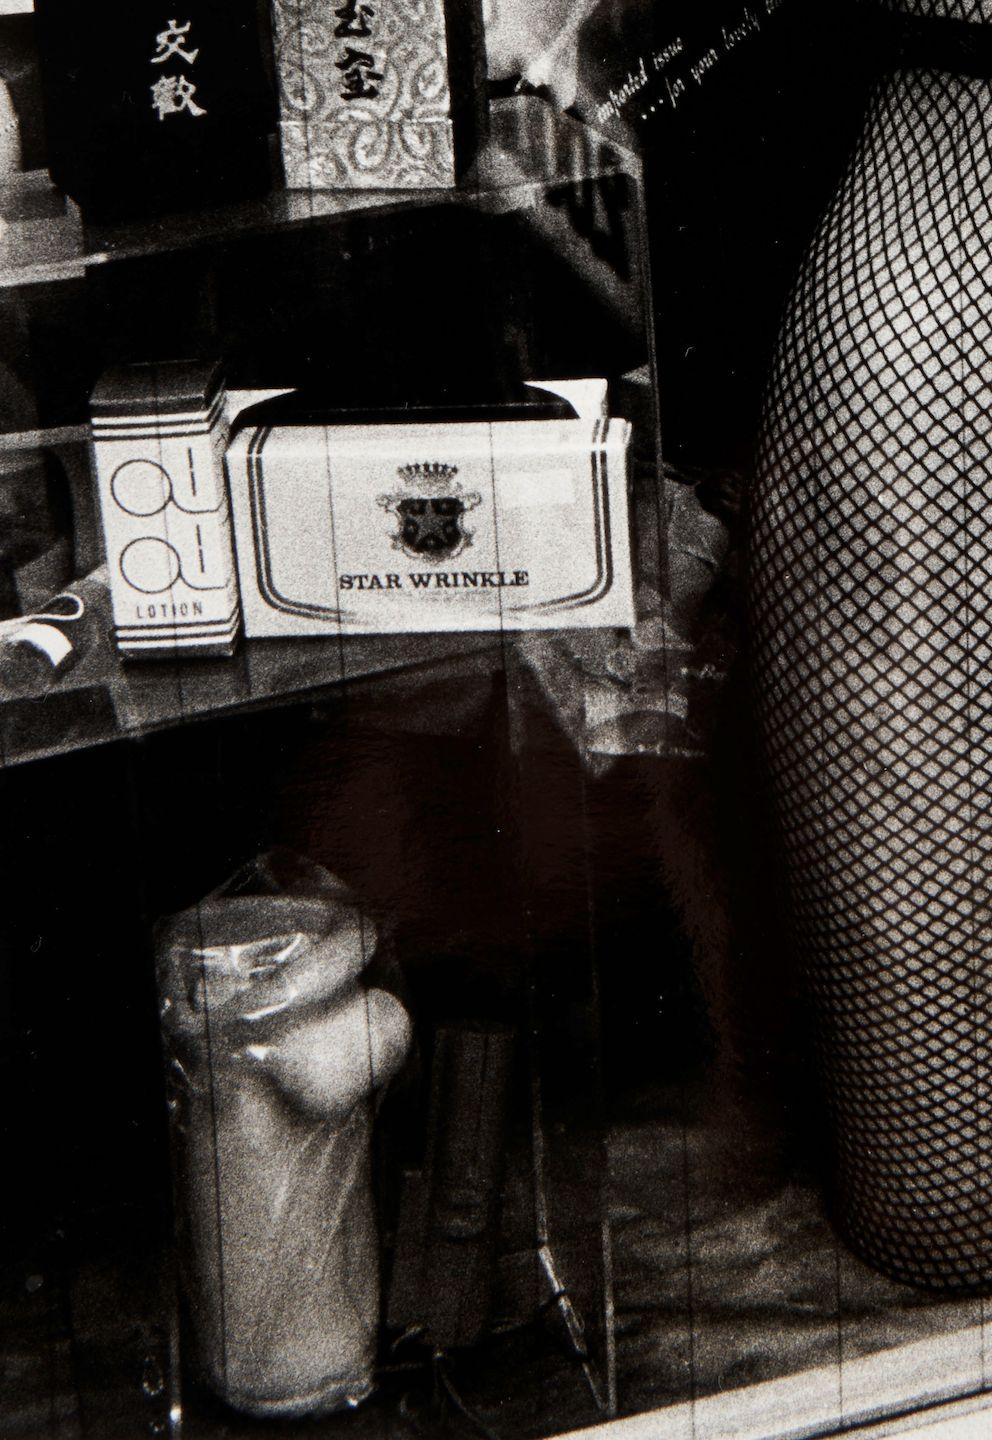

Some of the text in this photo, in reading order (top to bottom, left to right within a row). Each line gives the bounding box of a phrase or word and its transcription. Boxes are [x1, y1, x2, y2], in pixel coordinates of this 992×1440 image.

[691, 49, 718, 85] your
[339, 570, 530, 591] STAR WRINKLE
[136, 600, 204, 619] LOTION
